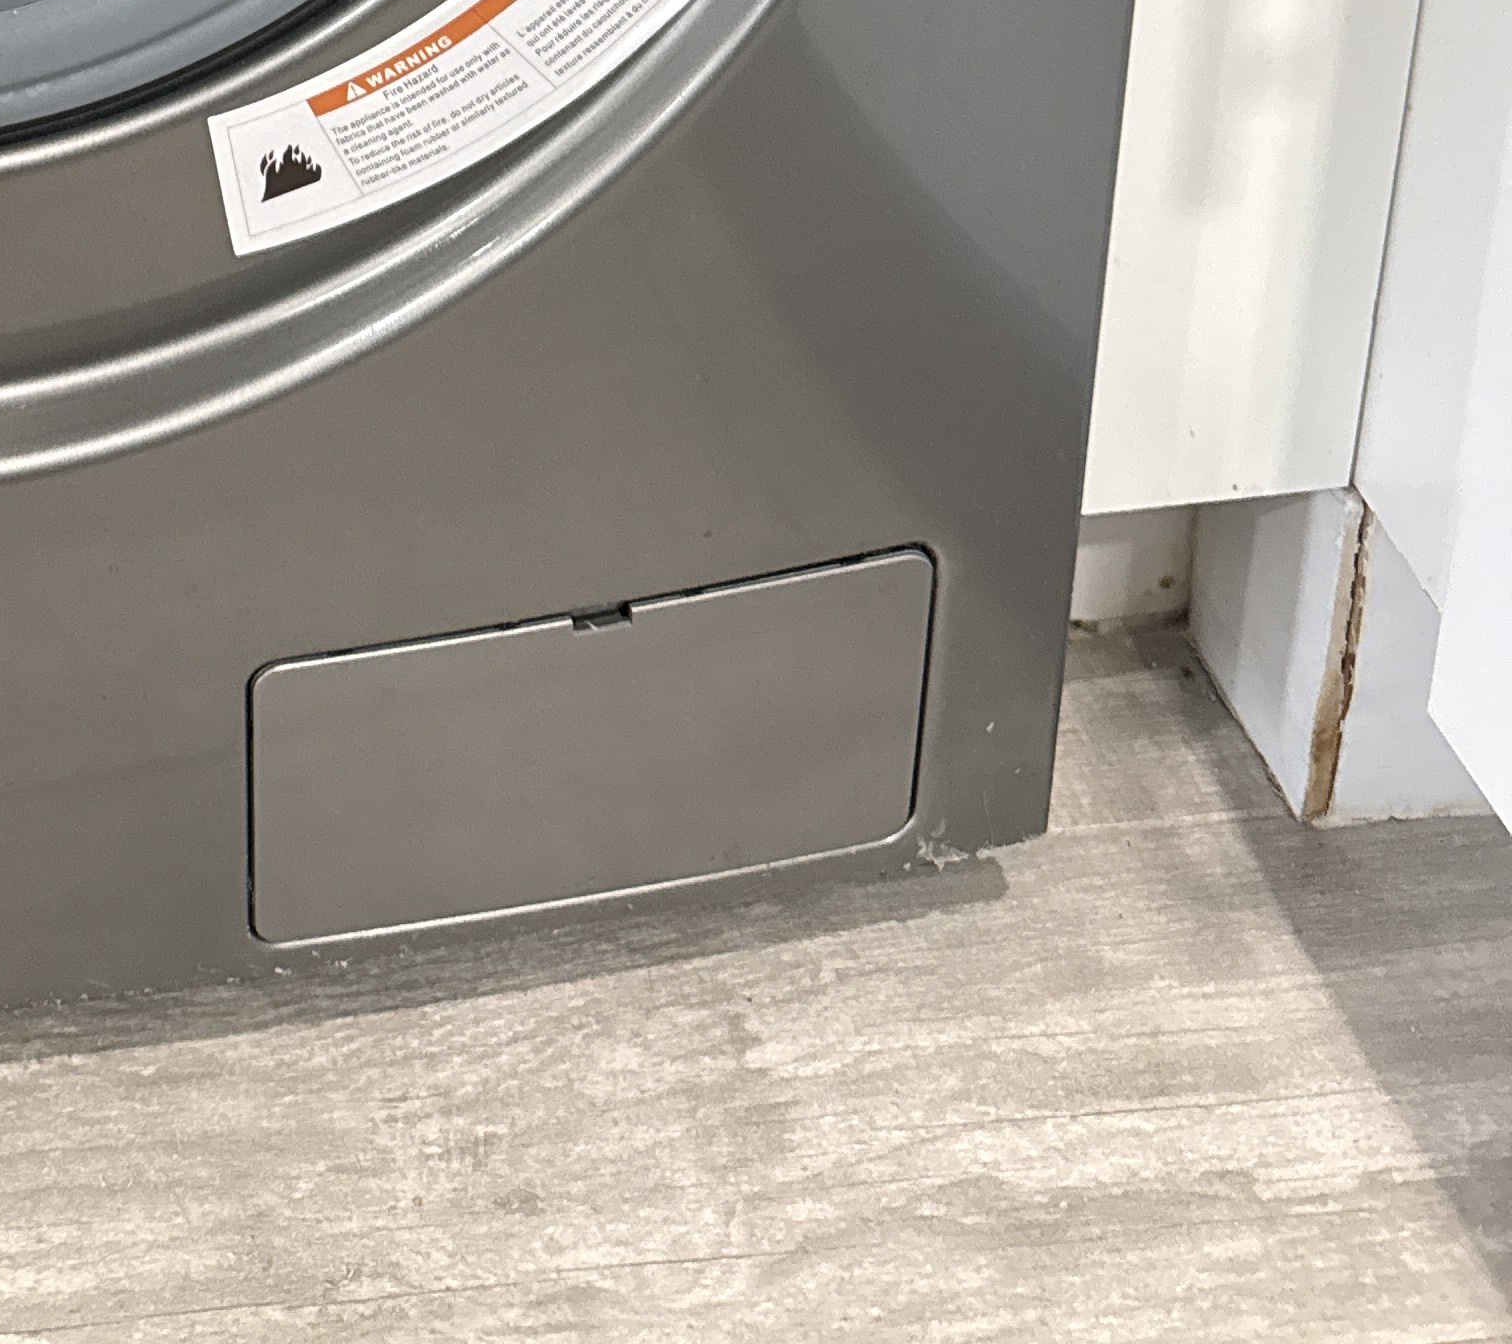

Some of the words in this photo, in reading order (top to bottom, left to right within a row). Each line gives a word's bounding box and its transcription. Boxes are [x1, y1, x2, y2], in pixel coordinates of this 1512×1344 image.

[366, 36, 453, 87] WARNING
[382, 84, 404, 100] Fire
[402, 63, 438, 89] Hazard
[331, 123, 349, 136] The
[349, 104, 391, 130] appliance
[391, 100, 400, 109] is
[399, 79, 436, 105] intended
[435, 73, 448, 84] for
[448, 64, 465, 77] use
[464, 53, 483, 69] only
[481, 41, 500, 56] with
